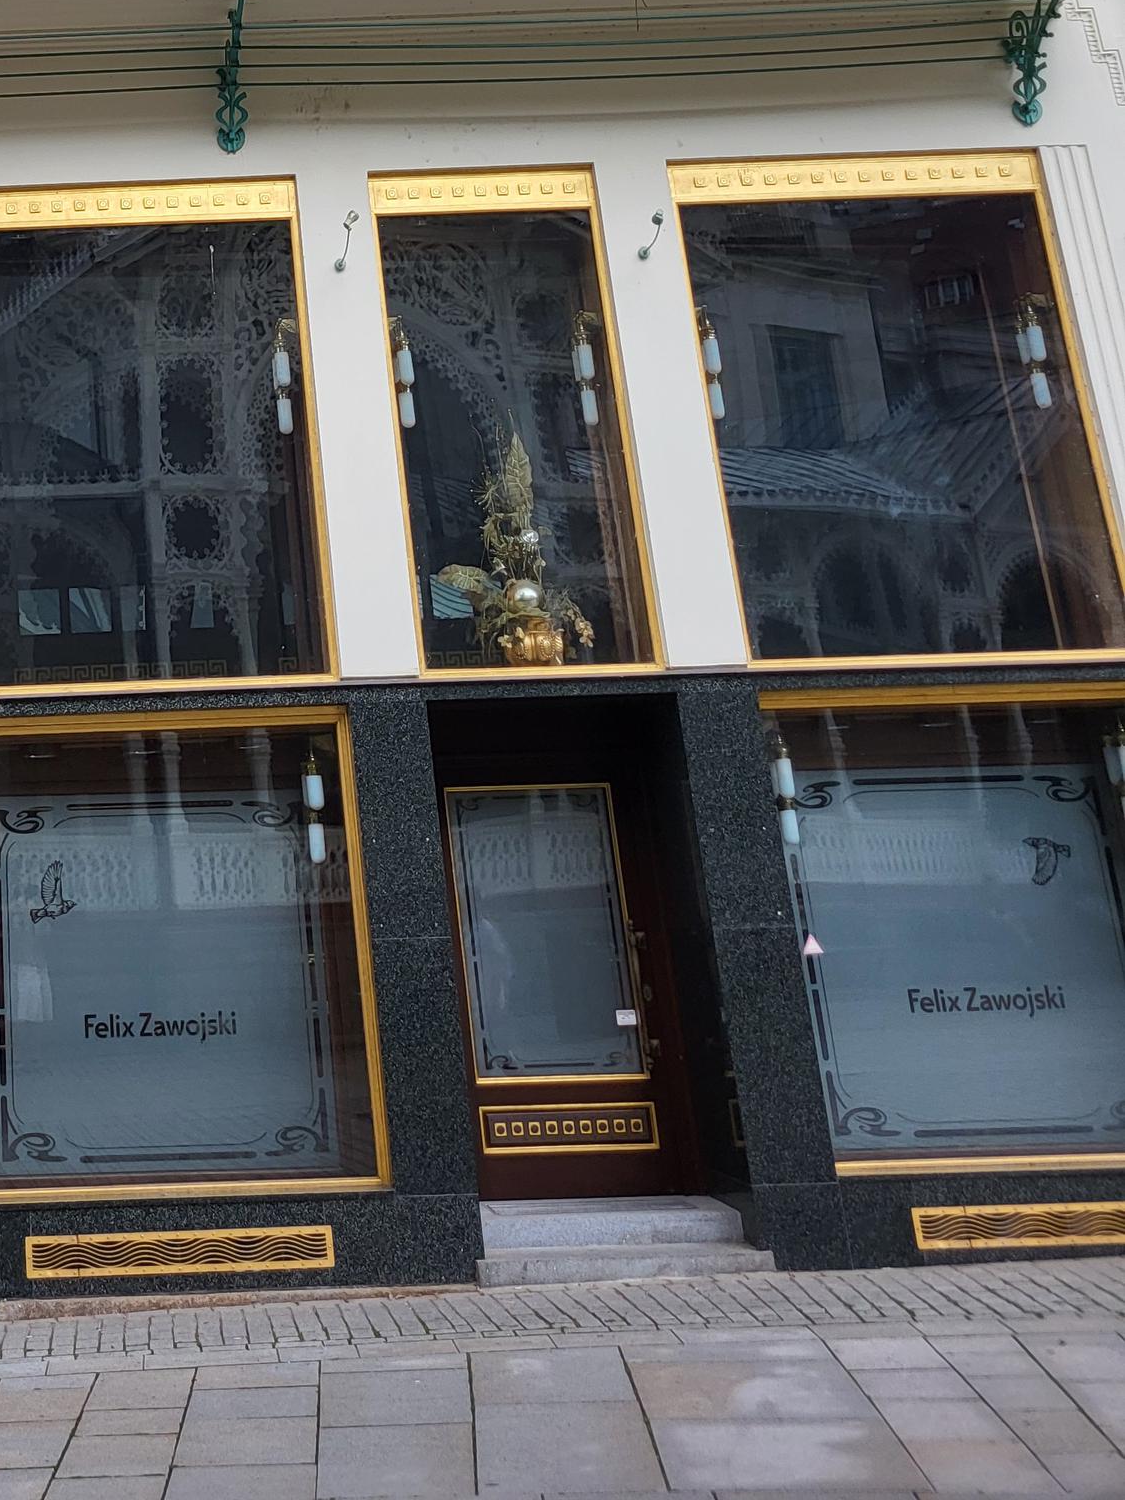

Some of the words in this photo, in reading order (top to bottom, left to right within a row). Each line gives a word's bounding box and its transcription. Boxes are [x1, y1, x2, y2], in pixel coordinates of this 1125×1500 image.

[907, 988, 961, 1013] Felix
[963, 985, 1066, 1017] Zawojski
[83, 1013, 135, 1038] Felix
[139, 1011, 237, 1042] Zawojski
